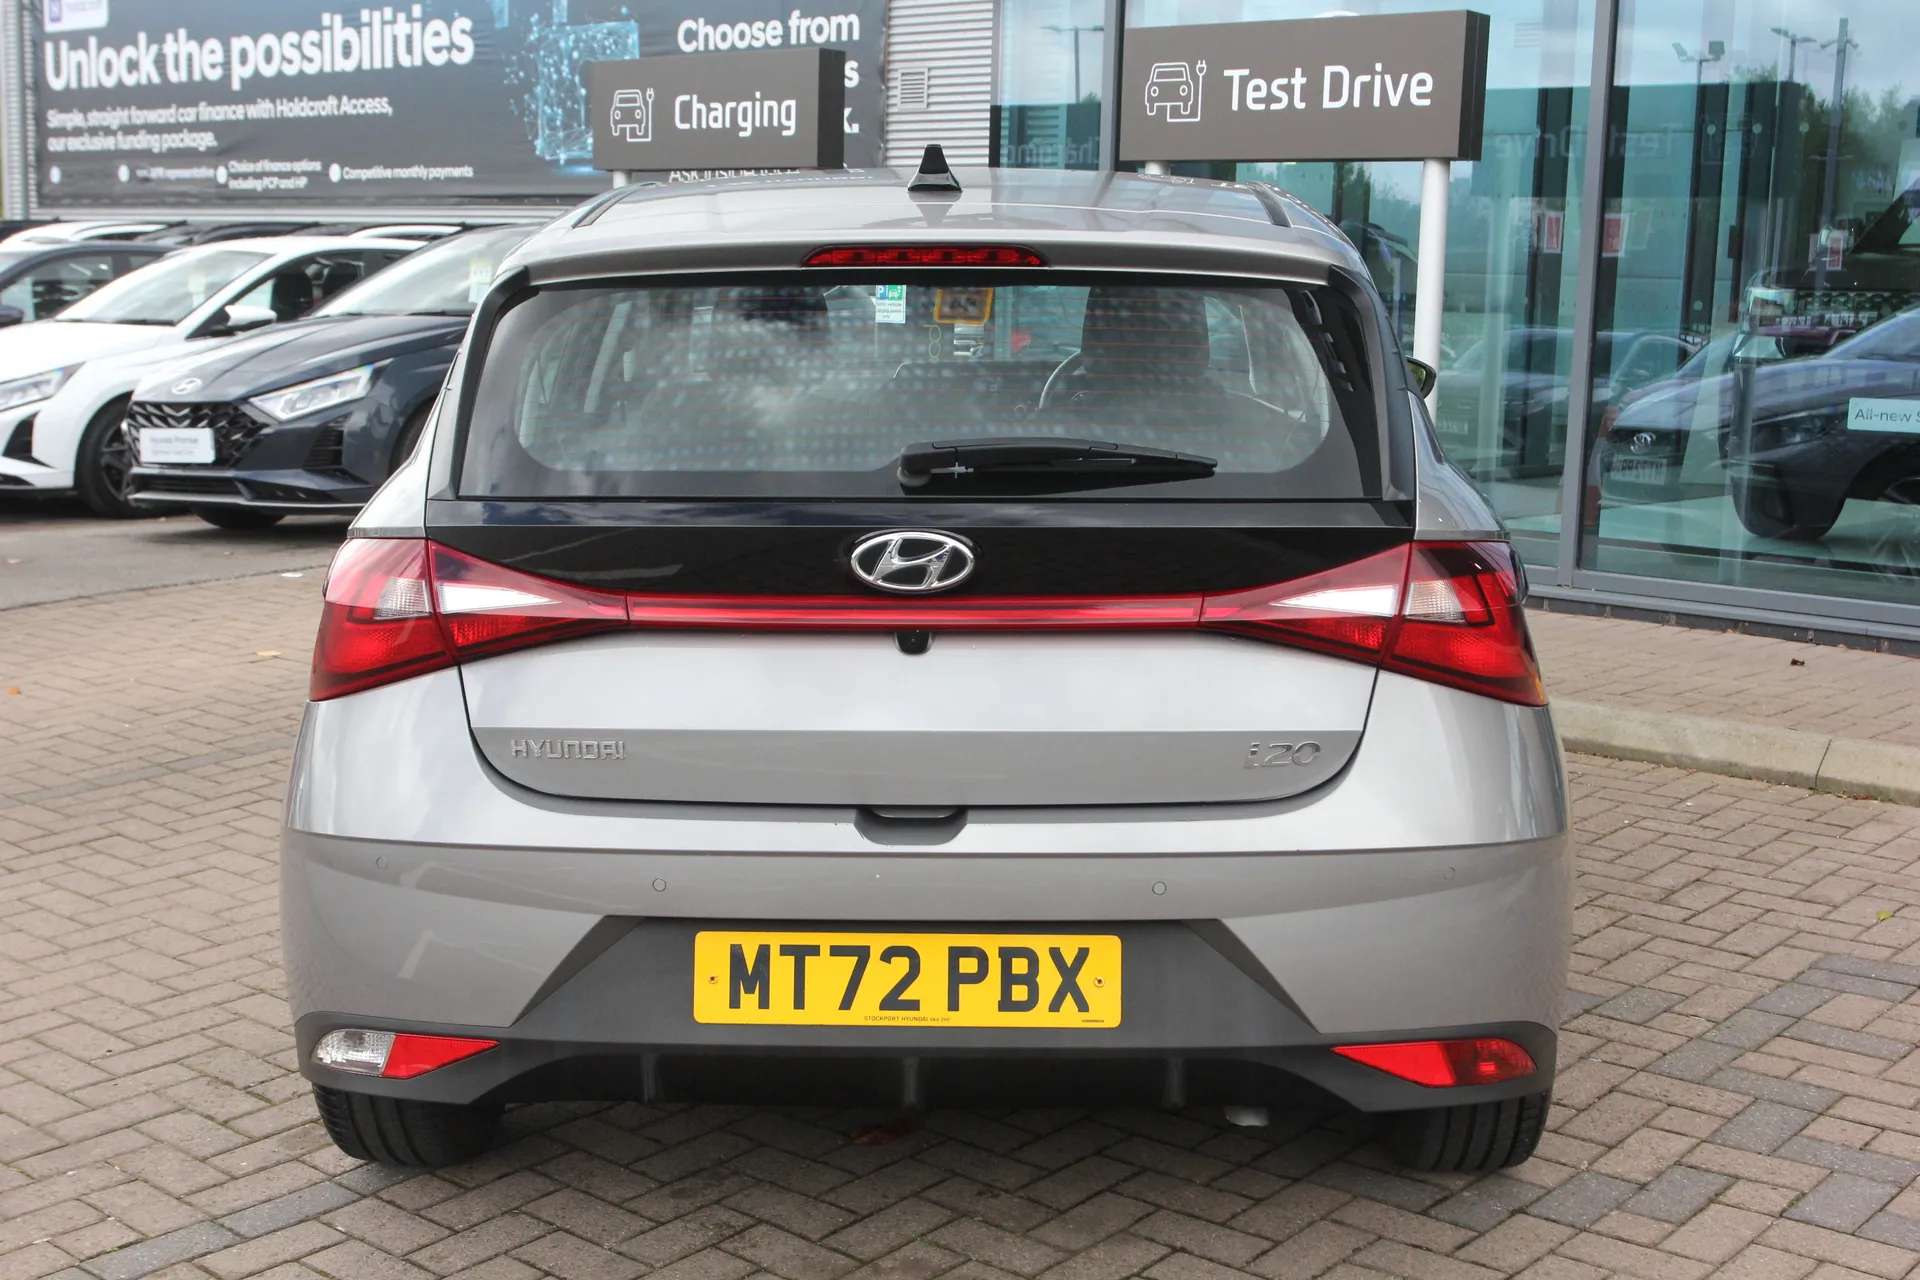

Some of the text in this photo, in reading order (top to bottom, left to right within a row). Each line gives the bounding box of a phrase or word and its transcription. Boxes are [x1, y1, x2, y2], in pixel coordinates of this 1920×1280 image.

[45, 4, 474, 90] Unlock the possibilities
[677, 9, 860, 52] Choose from
[1223, 62, 1433, 111] Test Drive
[46, 95, 393, 131] Simple, straight forward car finance with Holdcroft Access,
[674, 92, 796, 137] Charging
[48, 128, 218, 153] our exclusive funding package.
[343, 163, 474, 182] Competitive monthly payments
[1854, 407, 1912, 424] All-new
[510, 739, 625, 761] HYUNDAI
[1246, 741, 1321, 768] i20
[729, 944, 1090, 1014] MT72 PBX
